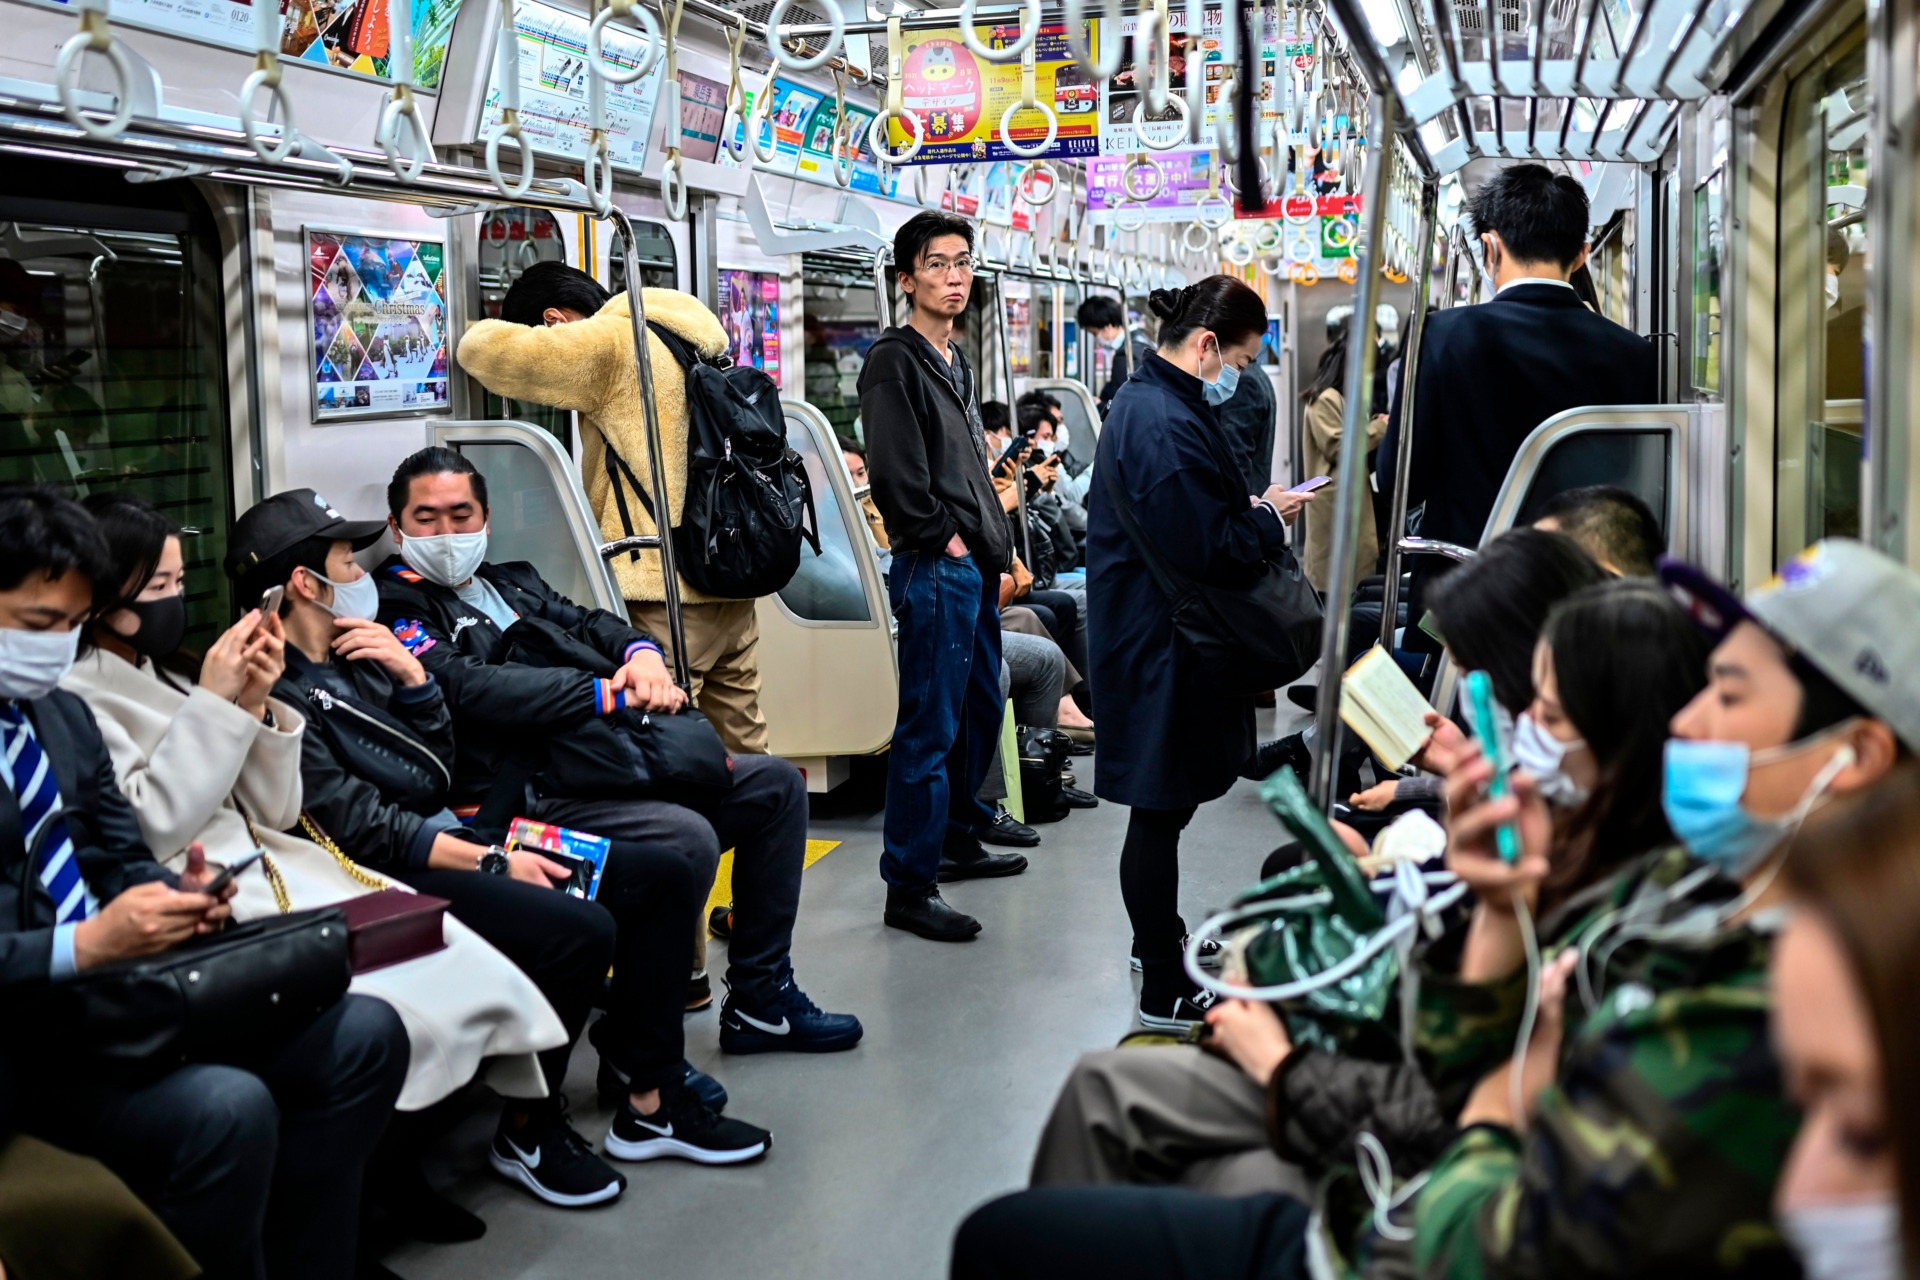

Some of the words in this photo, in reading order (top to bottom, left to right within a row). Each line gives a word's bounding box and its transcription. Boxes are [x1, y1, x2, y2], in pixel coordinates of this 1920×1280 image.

[904, 77, 975, 95] ヘッドマーク
[922, 98, 957, 106] デザイン
[1069, 139, 1095, 149] KEIKYU
[374, 299, 426, 316] Christmas
